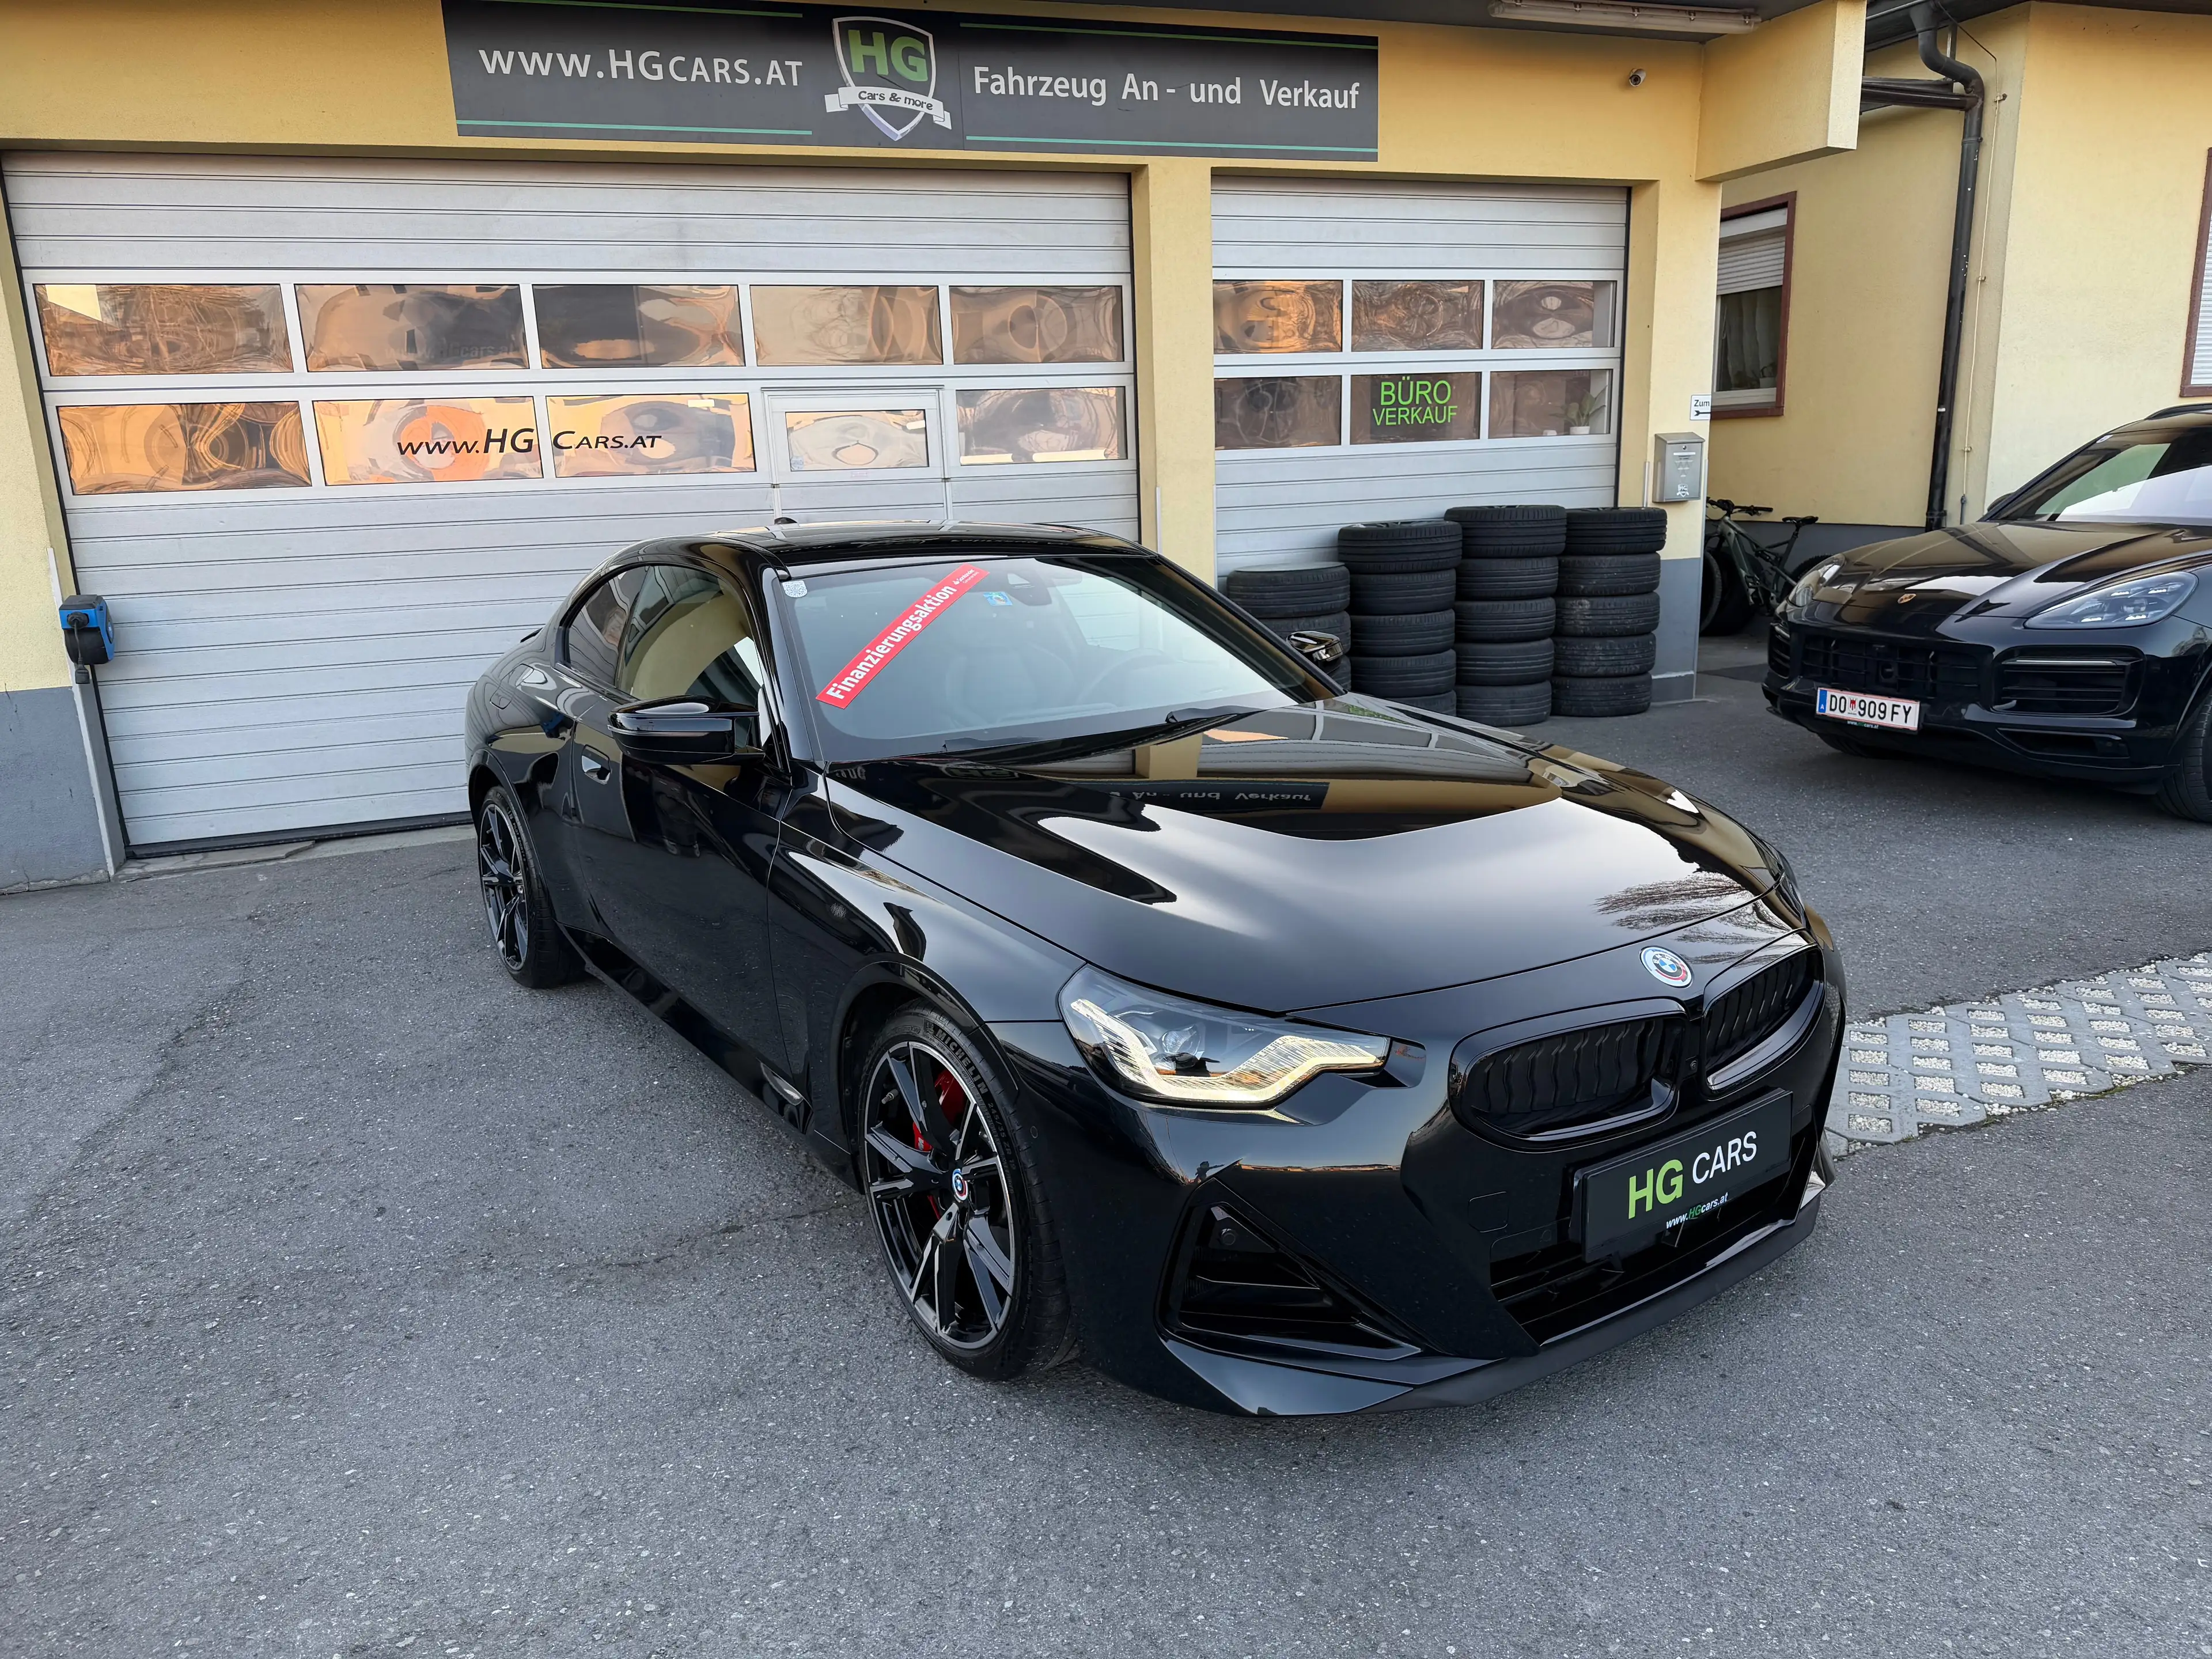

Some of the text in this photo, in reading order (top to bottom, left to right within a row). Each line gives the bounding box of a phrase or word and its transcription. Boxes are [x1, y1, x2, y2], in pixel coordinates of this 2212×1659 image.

[847, 29, 929, 82] HG
[858, 90, 933, 110] Cars & more
[974, 66, 1107, 106] Fahrzeug
[1190, 77, 1241, 104] und
[1260, 79, 1360, 109] Verkauf
[1380, 376, 1452, 406] BÜRO
[1694, 399, 1710, 407] Zum
[1372, 406, 1459, 426] VERKAUF
[826, 585, 957, 699] Finanzierungsaktion
[1829, 695, 1847, 713] DO
[1858, 699, 1887, 719] 909
[1891, 704, 1912, 724] FY
[935, 1028, 988, 1094] MICHELIN
[1628, 1130, 1758, 1219] HG CARS
[1666, 1192, 1728, 1229] www.HGcars.at
